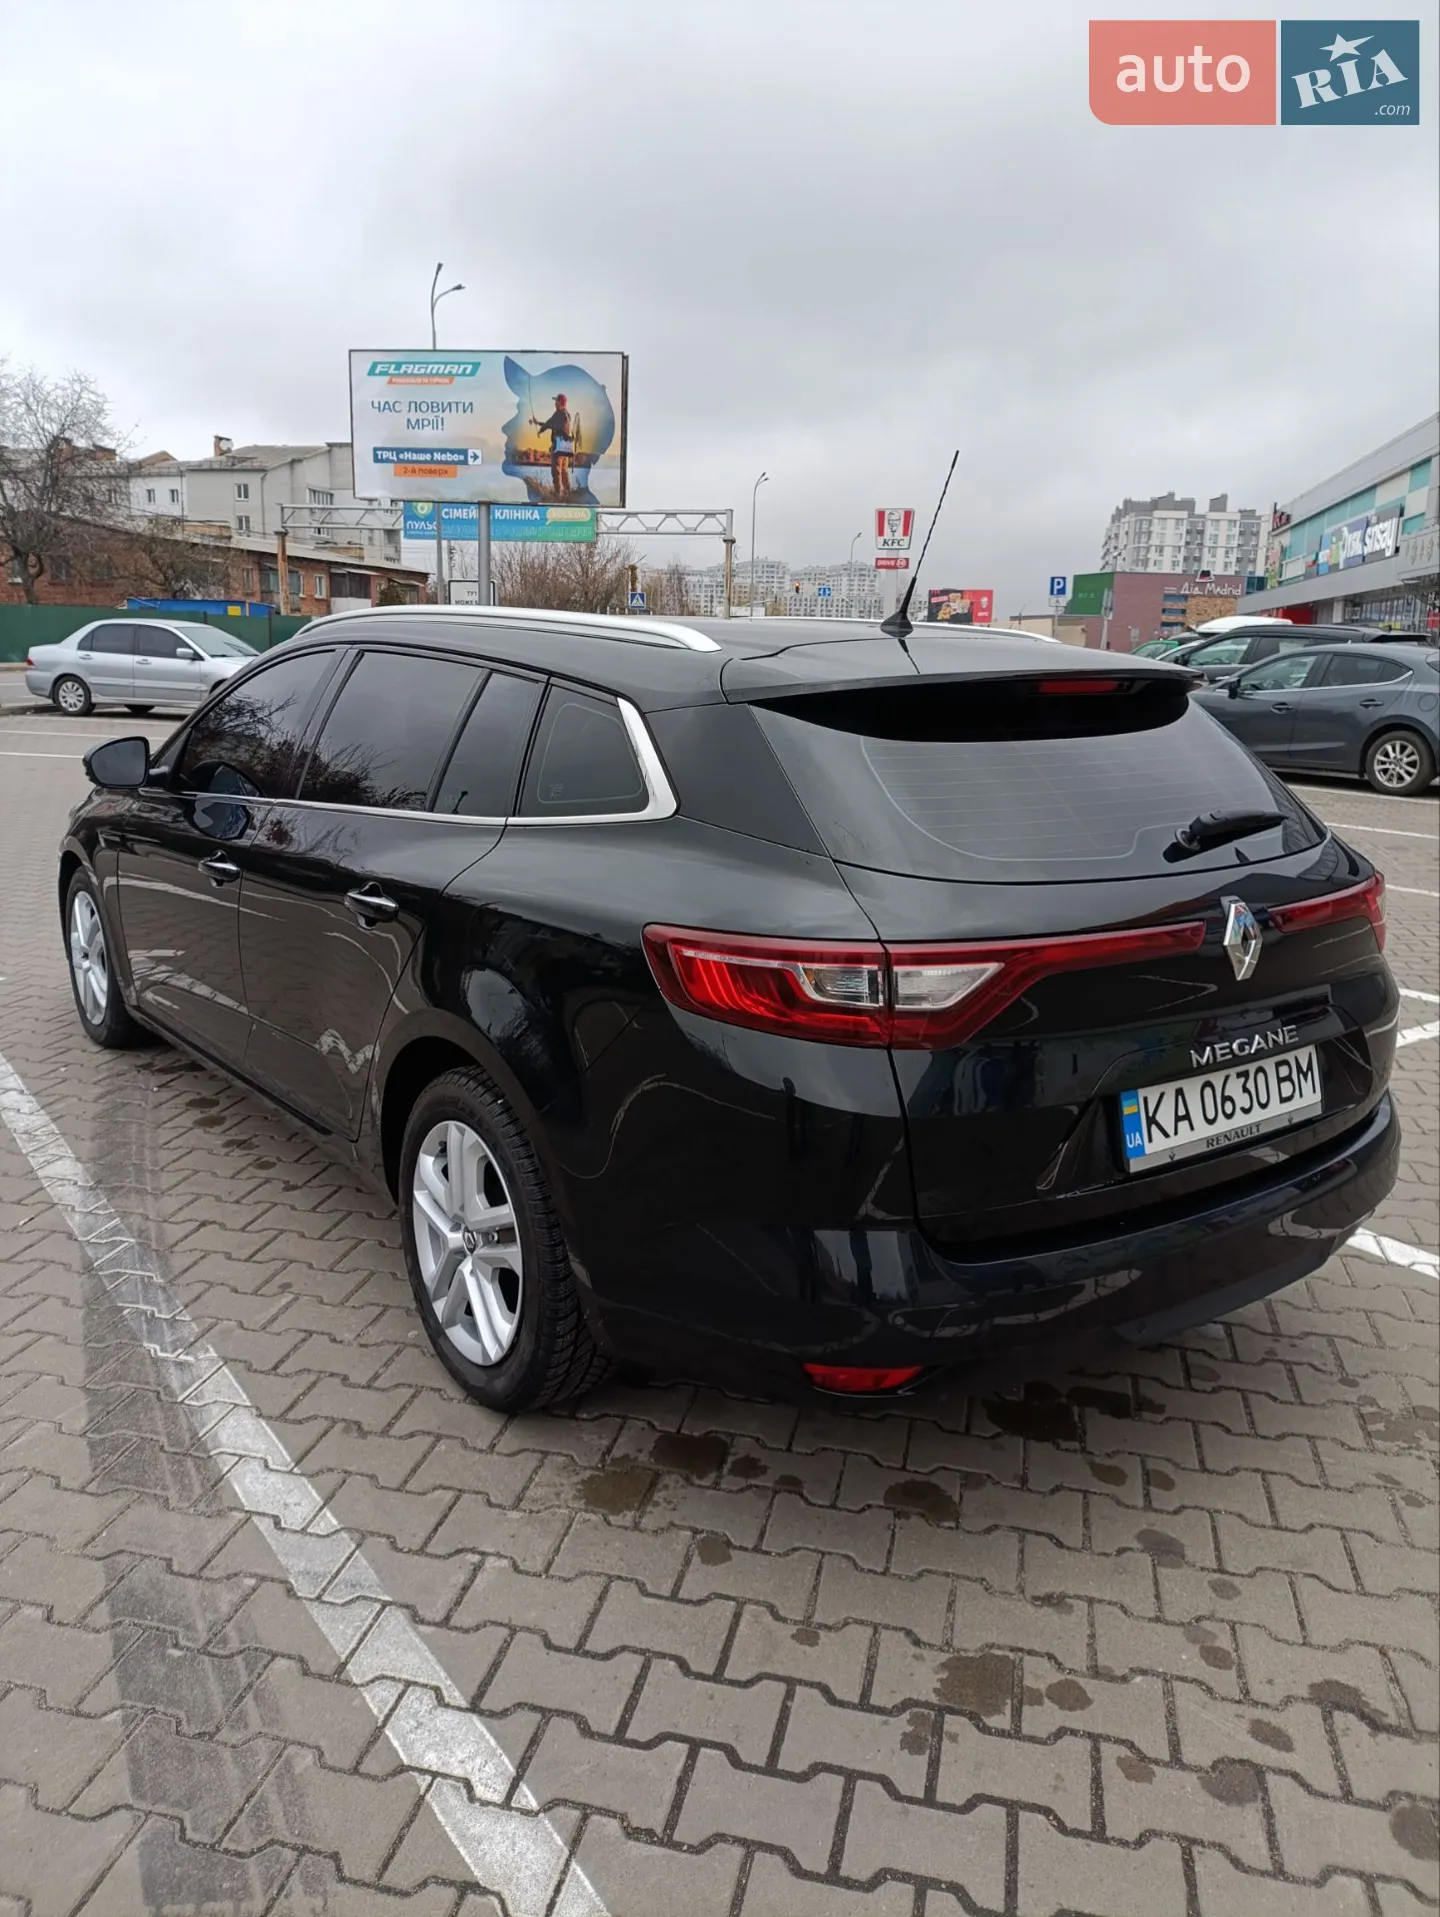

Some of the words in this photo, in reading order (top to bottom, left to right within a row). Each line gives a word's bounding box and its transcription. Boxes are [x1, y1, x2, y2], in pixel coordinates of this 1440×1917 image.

[374, 364, 473, 374] FLAGMAN
[371, 400, 402, 414] ЧАС
[407, 400, 474, 414] ЛОВИТИ
[406, 415, 445, 431] МРІЇ!
[375, 450, 397, 462] ТРЦ
[398, 451, 432, 461] «Наше
[433, 451, 465, 462] Nebo»
[418, 467, 448, 476] поверх
[495, 508, 540, 521] КЛІНІКА
[882, 538, 905, 547] KFC
[1053, 578, 1064, 595] P
[1190, 1024, 1299, 1068] MEGANE
[1142, 1087, 1195, 1144] KA
[1199, 1065, 1271, 1126] 0630
[1274, 1051, 1317, 1105] BM
[1126, 1131, 1143, 1149] UA
[1206, 1123, 1262, 1149] RENAULT
